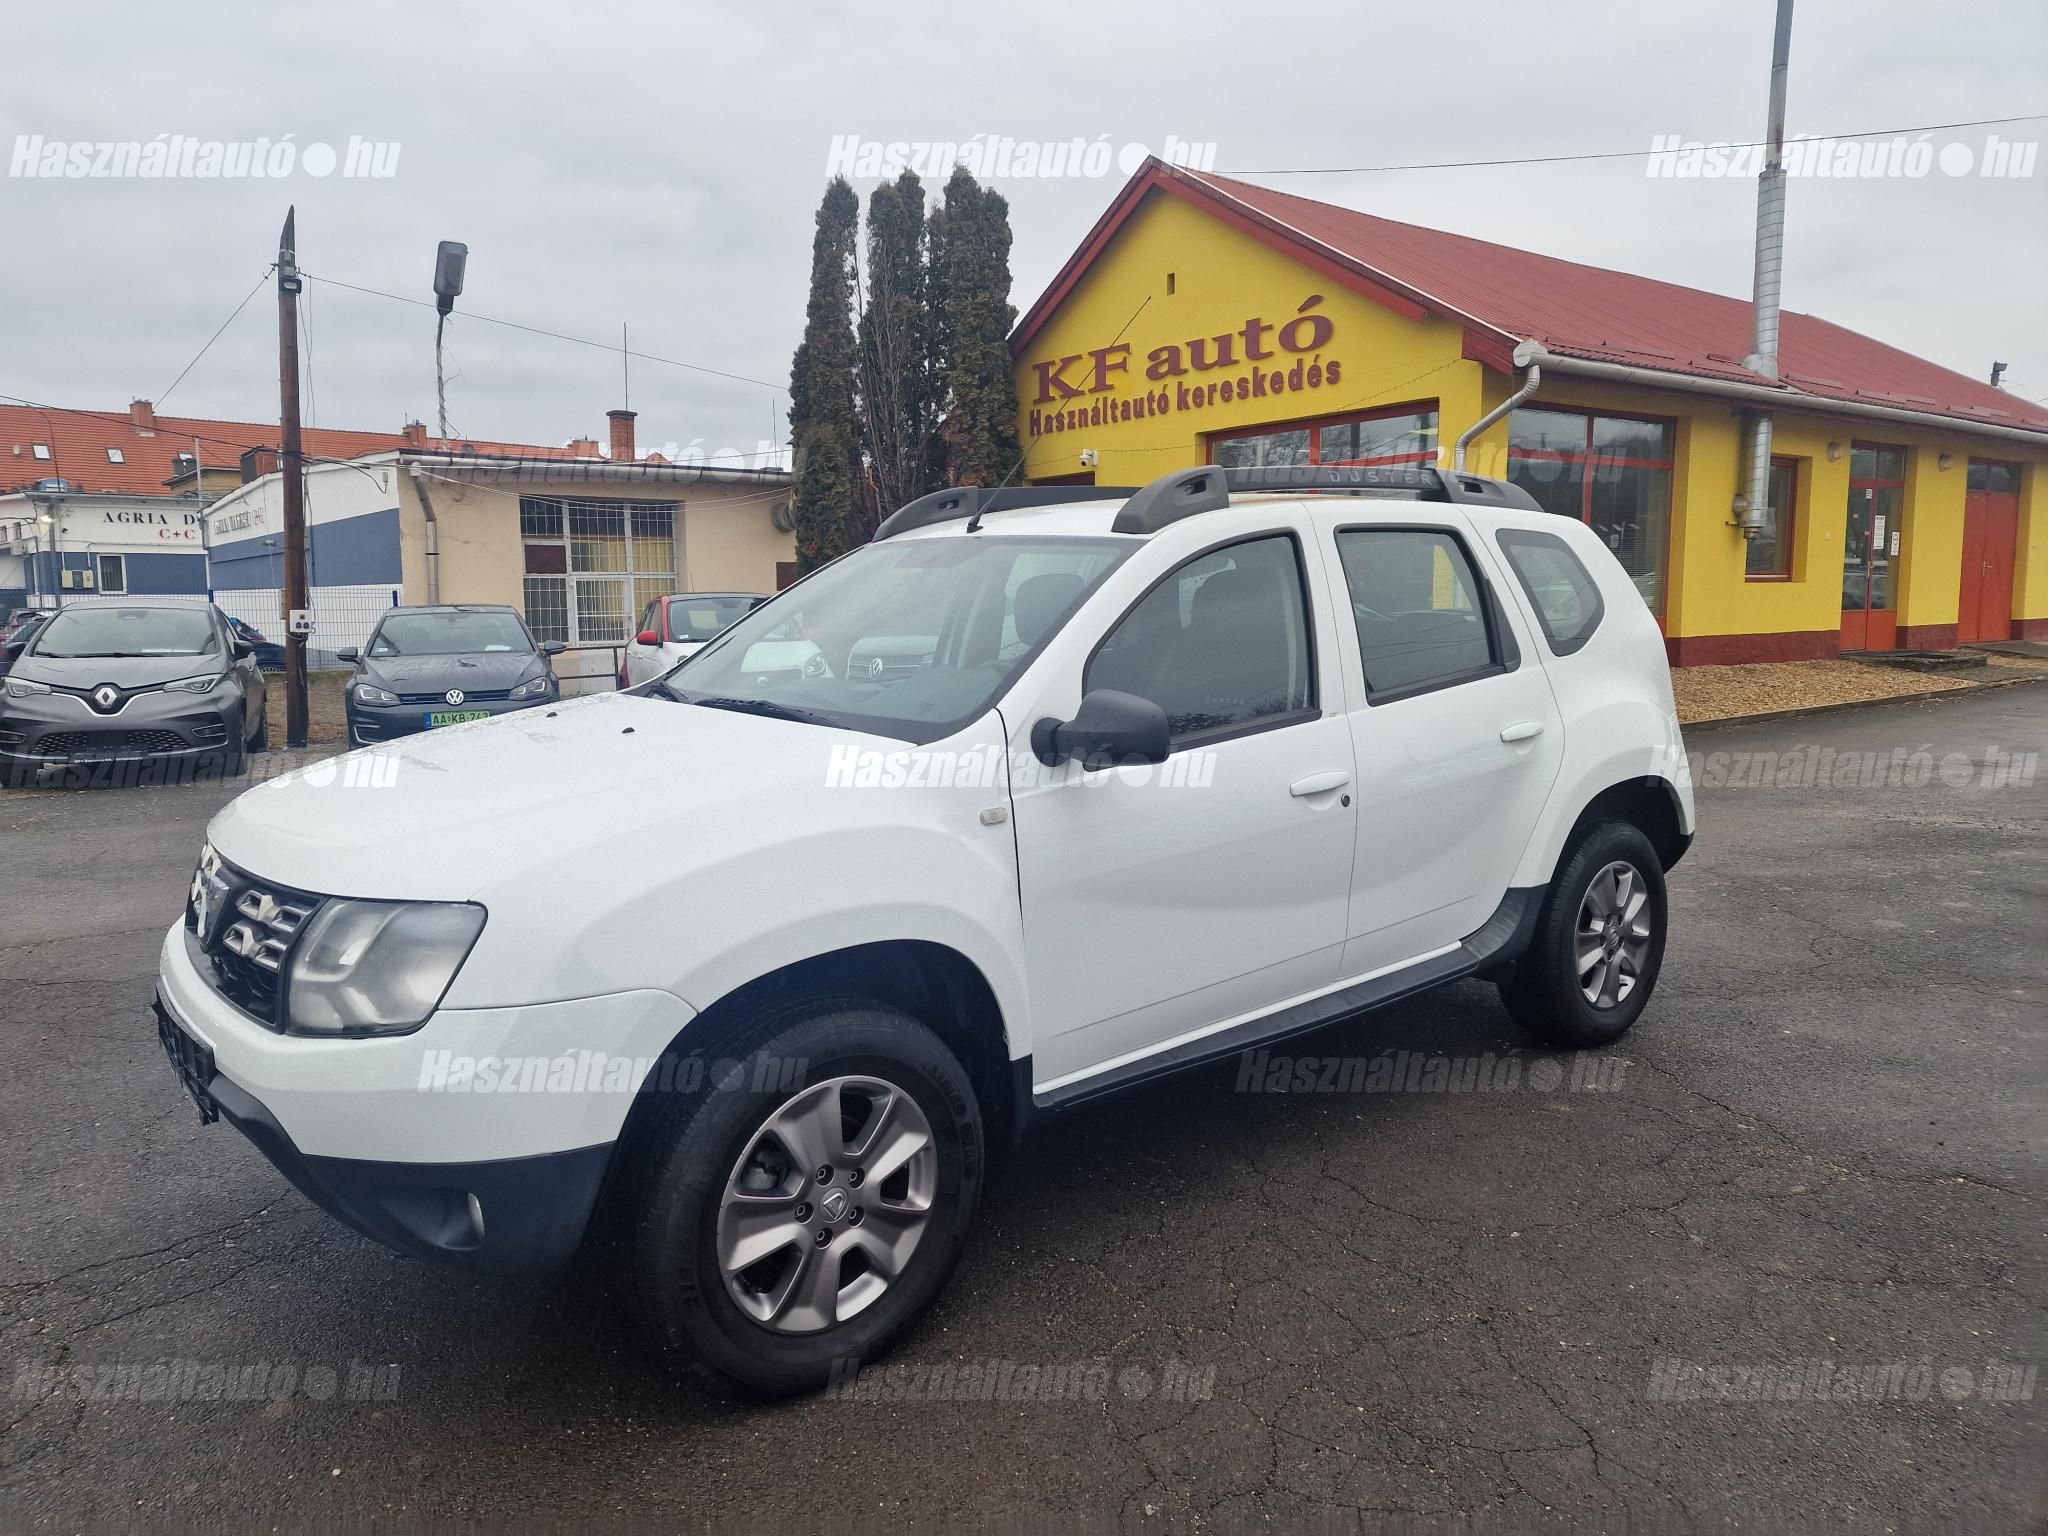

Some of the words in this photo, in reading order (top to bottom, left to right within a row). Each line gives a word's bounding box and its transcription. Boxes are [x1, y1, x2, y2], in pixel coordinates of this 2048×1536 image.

[1032, 342, 1132, 405] KF
[1145, 294, 1335, 381] autó
[1029, 383, 1170, 437] Használtautó
[1177, 354, 1341, 411] kereskedés
[1329, 469, 1434, 486] DUSTER
[103, 512, 168, 525] AGRIA
